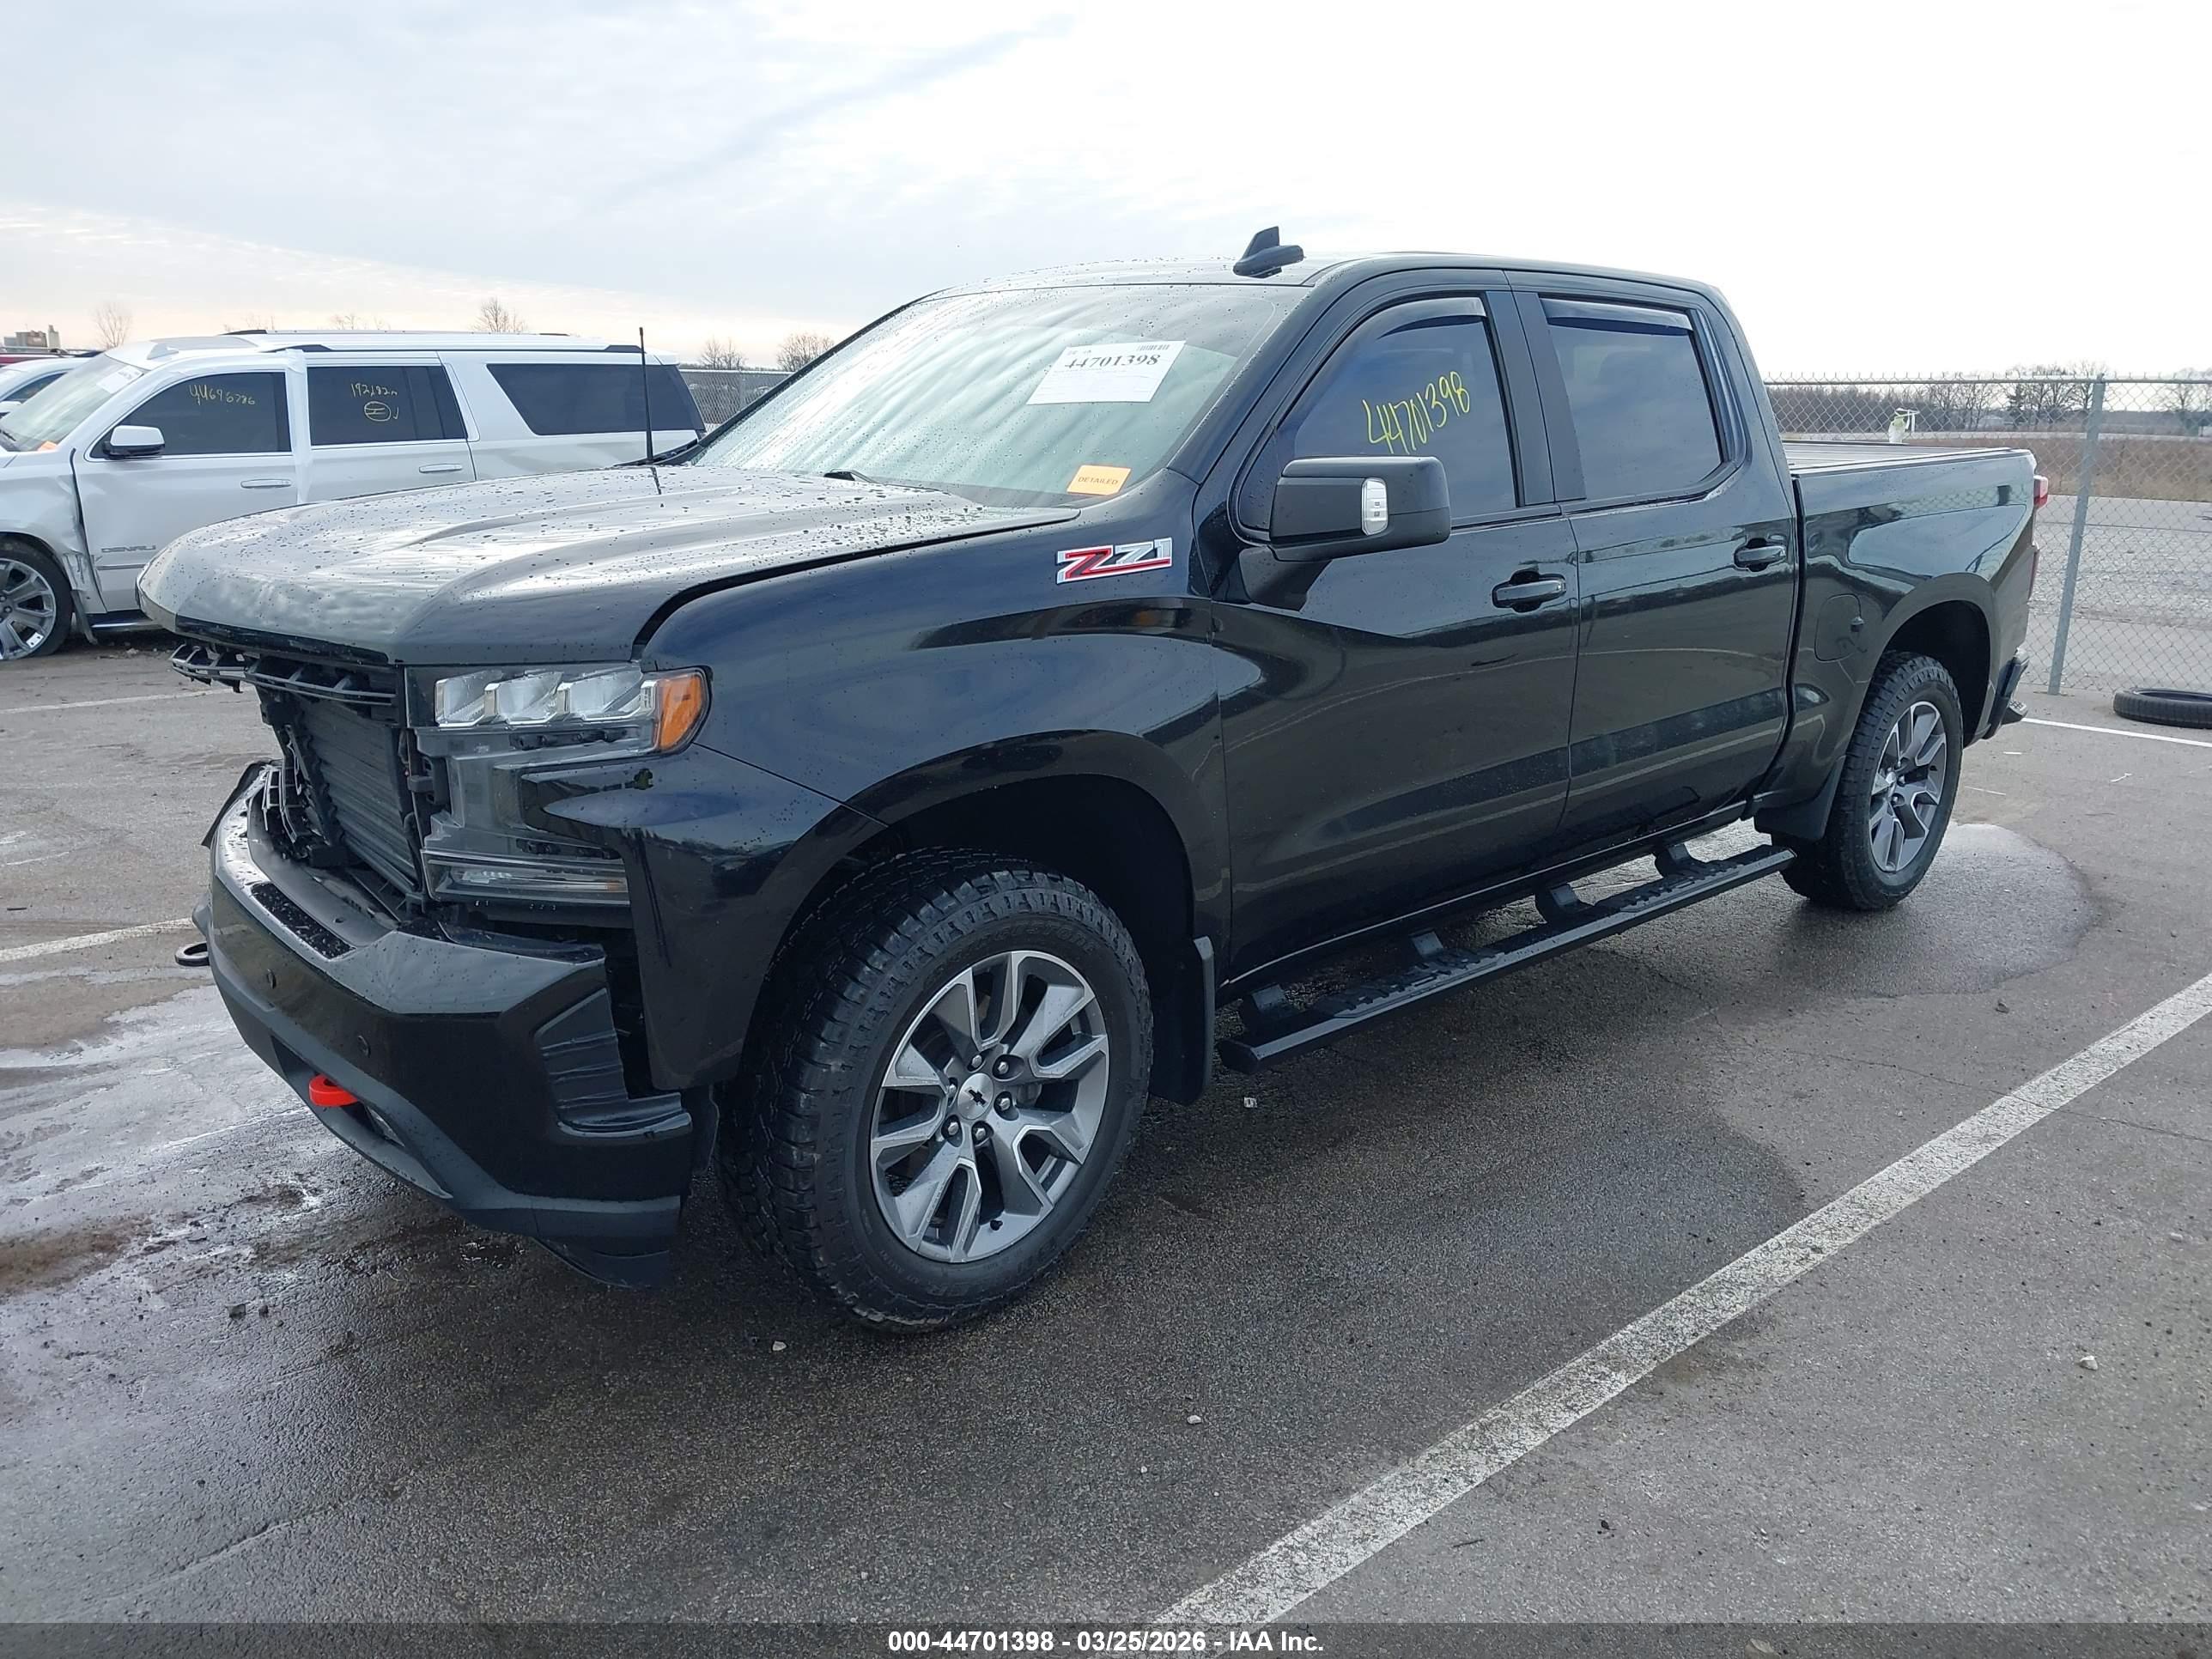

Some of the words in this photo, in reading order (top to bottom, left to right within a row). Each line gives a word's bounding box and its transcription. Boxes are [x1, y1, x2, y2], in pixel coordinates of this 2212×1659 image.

[1064, 354, 1161, 368] 44701398
[1362, 371, 1470, 455] 44701398
[1078, 477, 1118, 485] DETAILED
[1056, 537, 1173, 585] Z71
